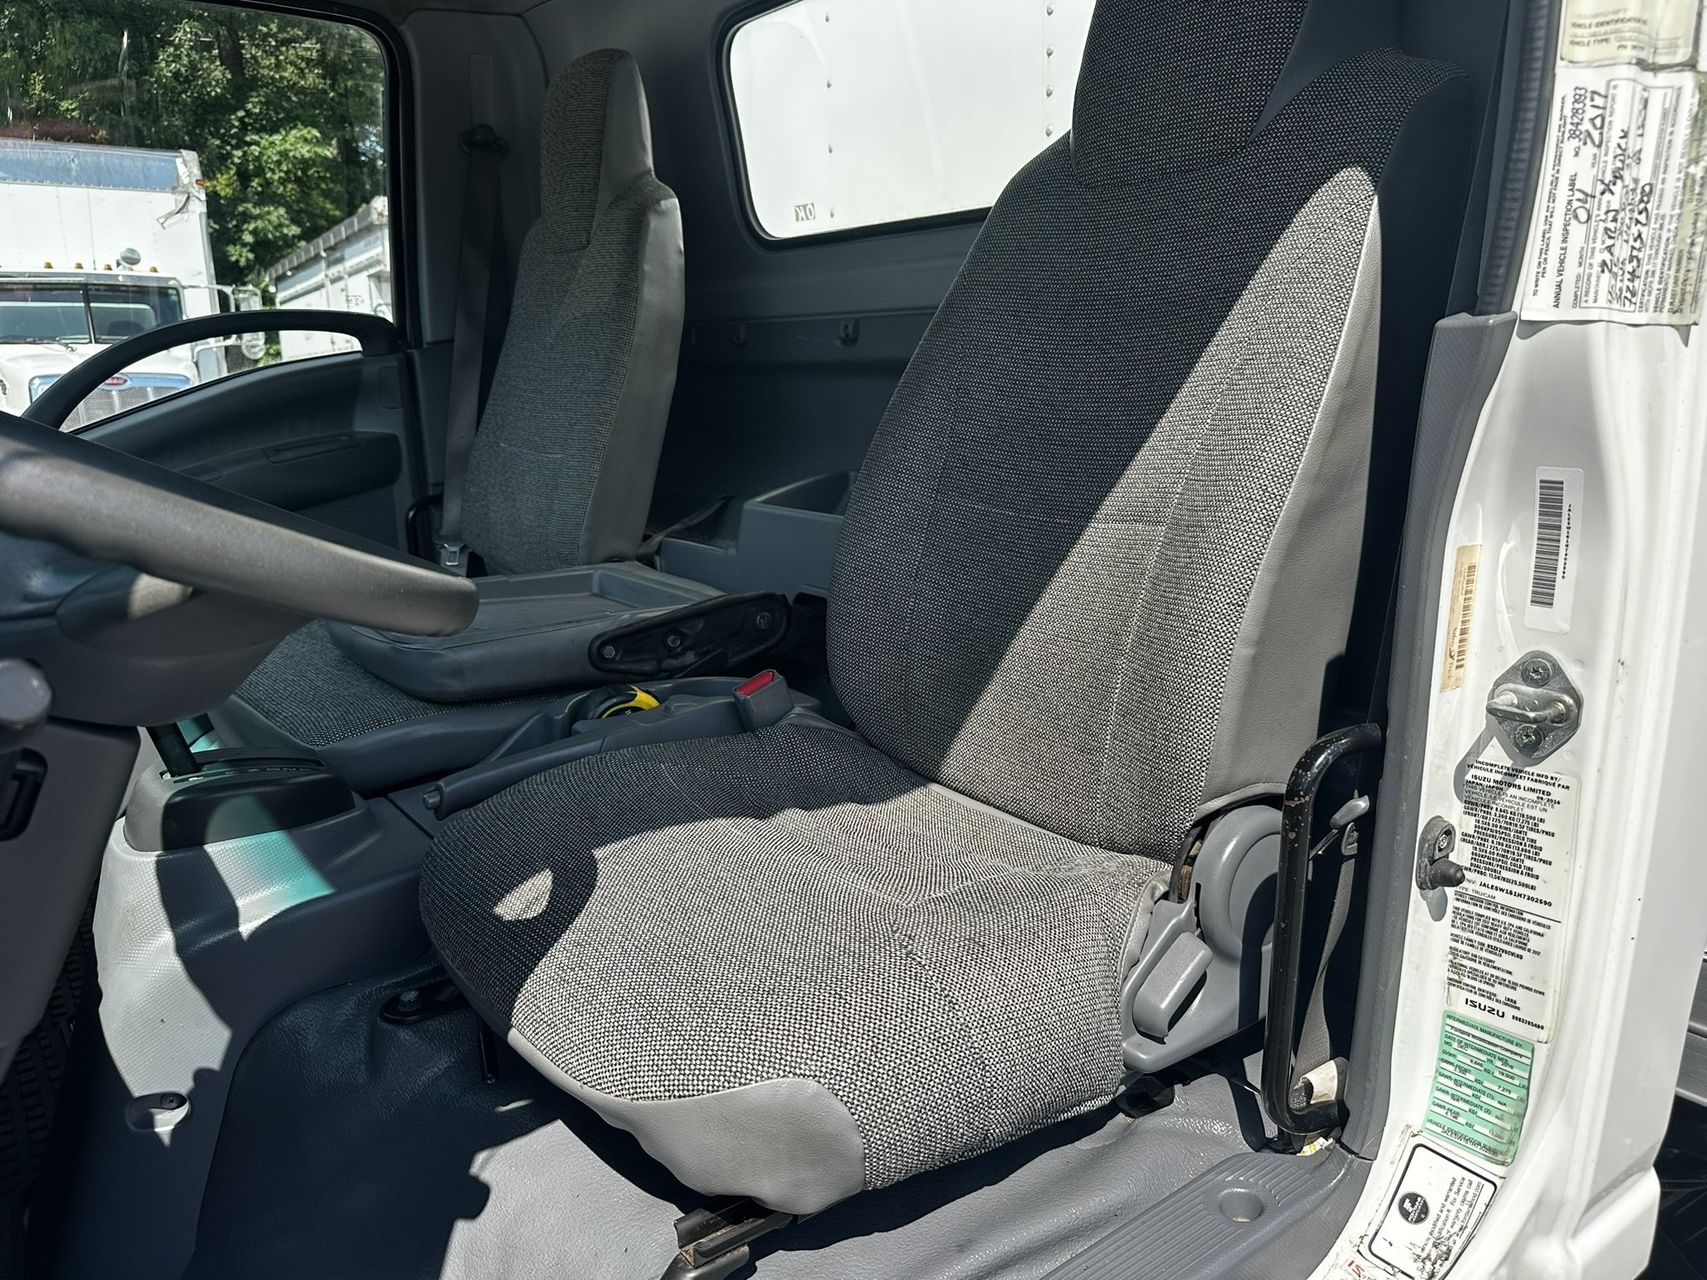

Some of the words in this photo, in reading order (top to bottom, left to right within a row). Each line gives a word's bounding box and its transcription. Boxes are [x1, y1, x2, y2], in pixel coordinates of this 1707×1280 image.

[1561, 199, 1574, 244] INSPECTION
[1556, 246, 1568, 277] VEHICLE
[1552, 279, 1564, 308] ANNUAL
[1476, 759, 1510, 772] INCOMPLETE
[1494, 769, 1526, 781] INCOMPLET
[1493, 778, 1521, 791] MOTORS
[1523, 785, 1551, 797] LIMITED
[1465, 997, 1505, 1019] ISUZU
